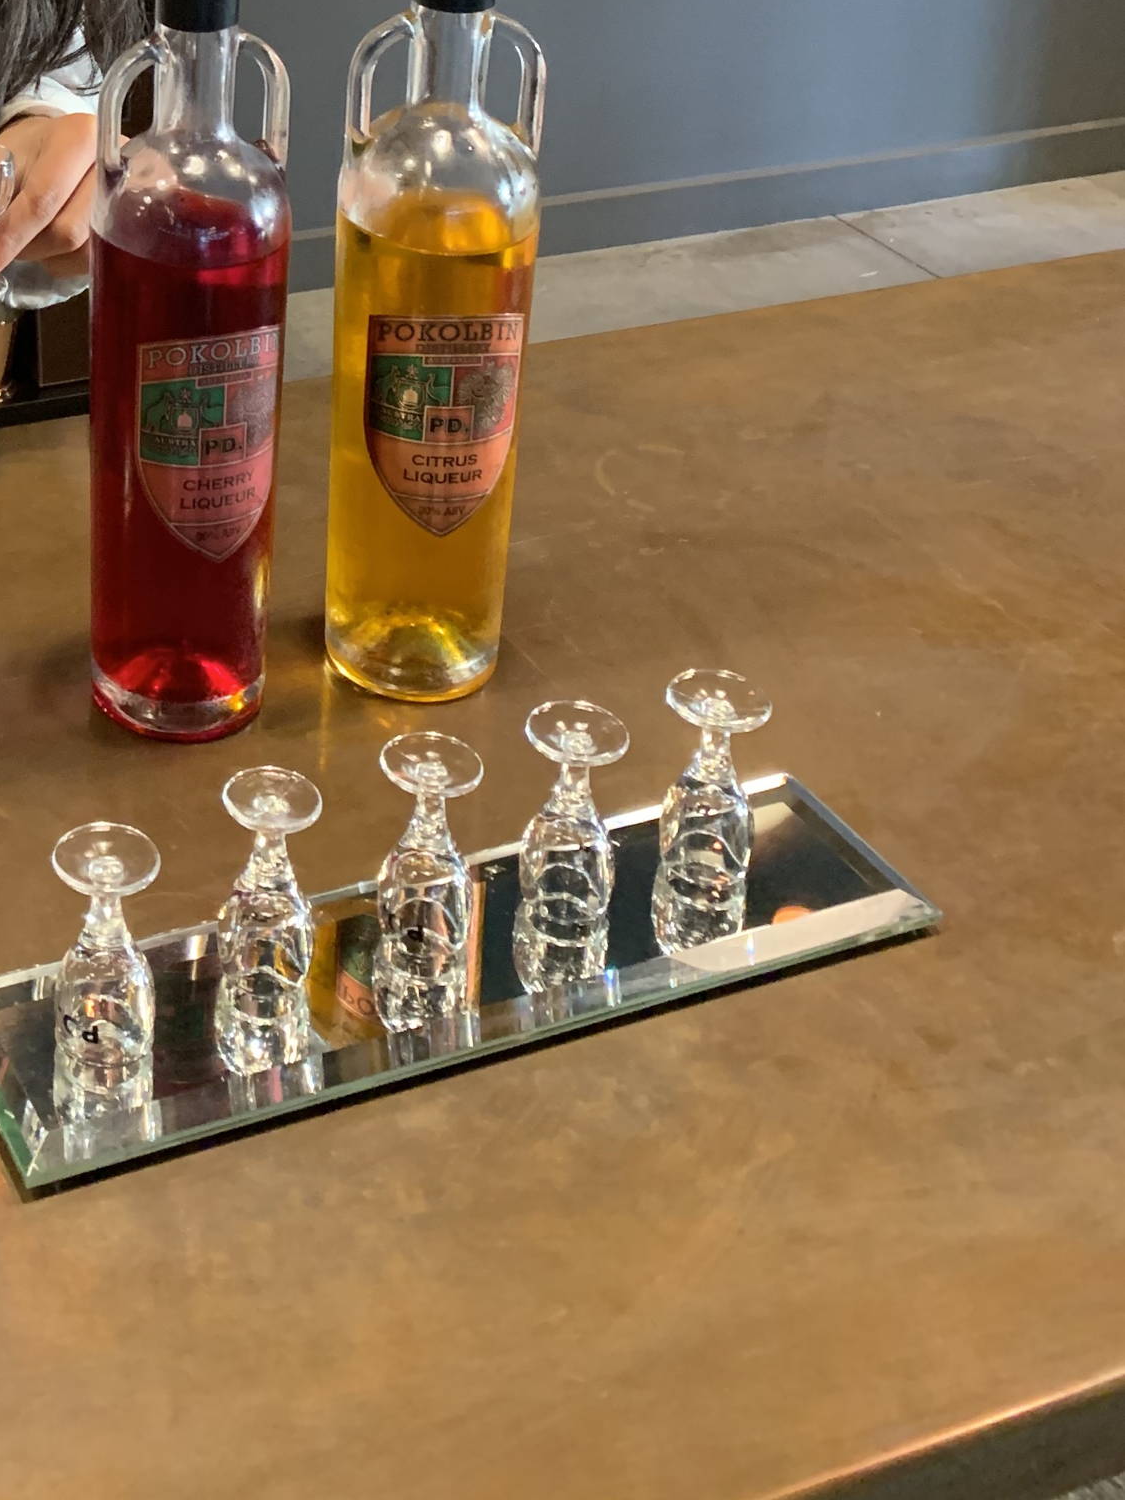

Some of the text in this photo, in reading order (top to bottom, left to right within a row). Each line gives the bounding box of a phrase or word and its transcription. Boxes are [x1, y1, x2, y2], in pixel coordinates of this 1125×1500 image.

[377, 321, 519, 343] POKOLBIN
[429, 417, 470, 434] PD.
[205, 436, 243, 456] PD.
[411, 453, 478, 468] CITRUS
[182, 468, 255, 491] CHERRY
[402, 468, 483, 485] LIQUEUR
[179, 486, 256, 510] LIQUEUR
